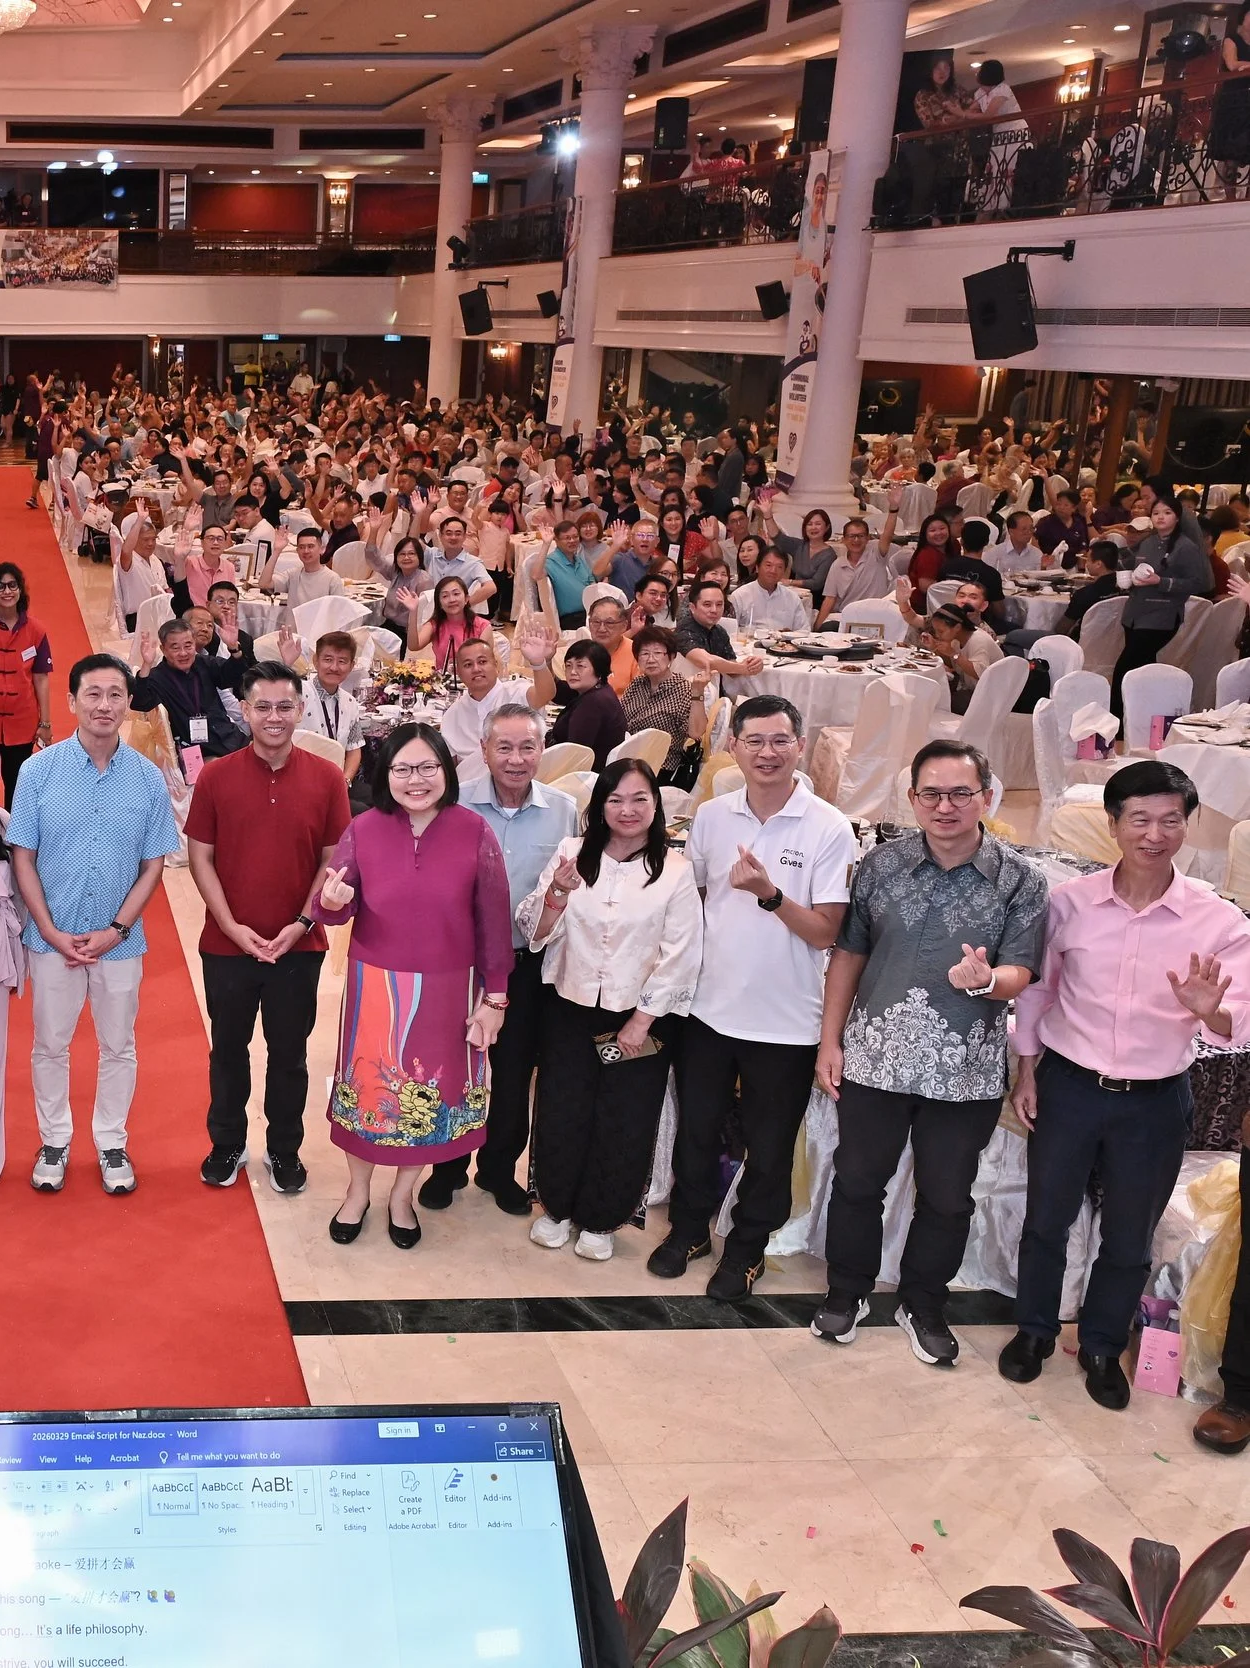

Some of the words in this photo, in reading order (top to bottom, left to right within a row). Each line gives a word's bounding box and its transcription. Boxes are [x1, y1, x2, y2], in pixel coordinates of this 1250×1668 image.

[779, 856, 803, 869] Gives
[32, 1432, 70, 1441] 20260329
[96, 1431, 118, 1442] Script
[119, 1430, 131, 1439] for
[132, 1429, 166, 1439] Naz.docx
[177, 1429, 198, 1438] Word
[385, 1426, 403, 1436] Sign
[404, 1426, 411, 1434] in
[510, 1447, 534, 1456] Share
[39, 1455, 58, 1464] View
[74, 1455, 92, 1464] Help
[110, 1453, 140, 1462] Acrobat
[176, 1452, 189, 1461] Tell
[205, 1452, 222, 1460] what
[224, 1454, 238, 1462] you
[240, 1452, 258, 1460] want
[270, 1451, 281, 1459] do
[340, 1471, 356, 1480] Find
[341, 1488, 370, 1498] Replace
[398, 1495, 422, 1504] Create
[444, 1494, 466, 1503] Editor
[483, 1494, 512, 1502] Add-ins
[163, 1502, 190, 1510] Normal
[208, 1501, 219, 1509] No
[257, 1500, 288, 1510] Heading
[343, 1505, 365, 1514] Select
[407, 1507, 422, 1515] PDF
[343, 1523, 367, 1533] Editing
[388, 1522, 410, 1530] Adobe
[411, 1522, 437, 1530] Acrobat
[448, 1521, 467, 1529] Editor
[487, 1520, 513, 1528] Add-ins
[218, 1526, 237, 1535] Styles
[18, 1595, 46, 1606] song
[36, 1624, 52, 1635] It's
[55, 1627, 63, 1635] a
[66, 1624, 82, 1635] life
[85, 1623, 148, 1637] philosophy.
[33, 1660, 53, 1668] you
[57, 1657, 75, 1668] will
[78, 1656, 128, 1668] succeed.
